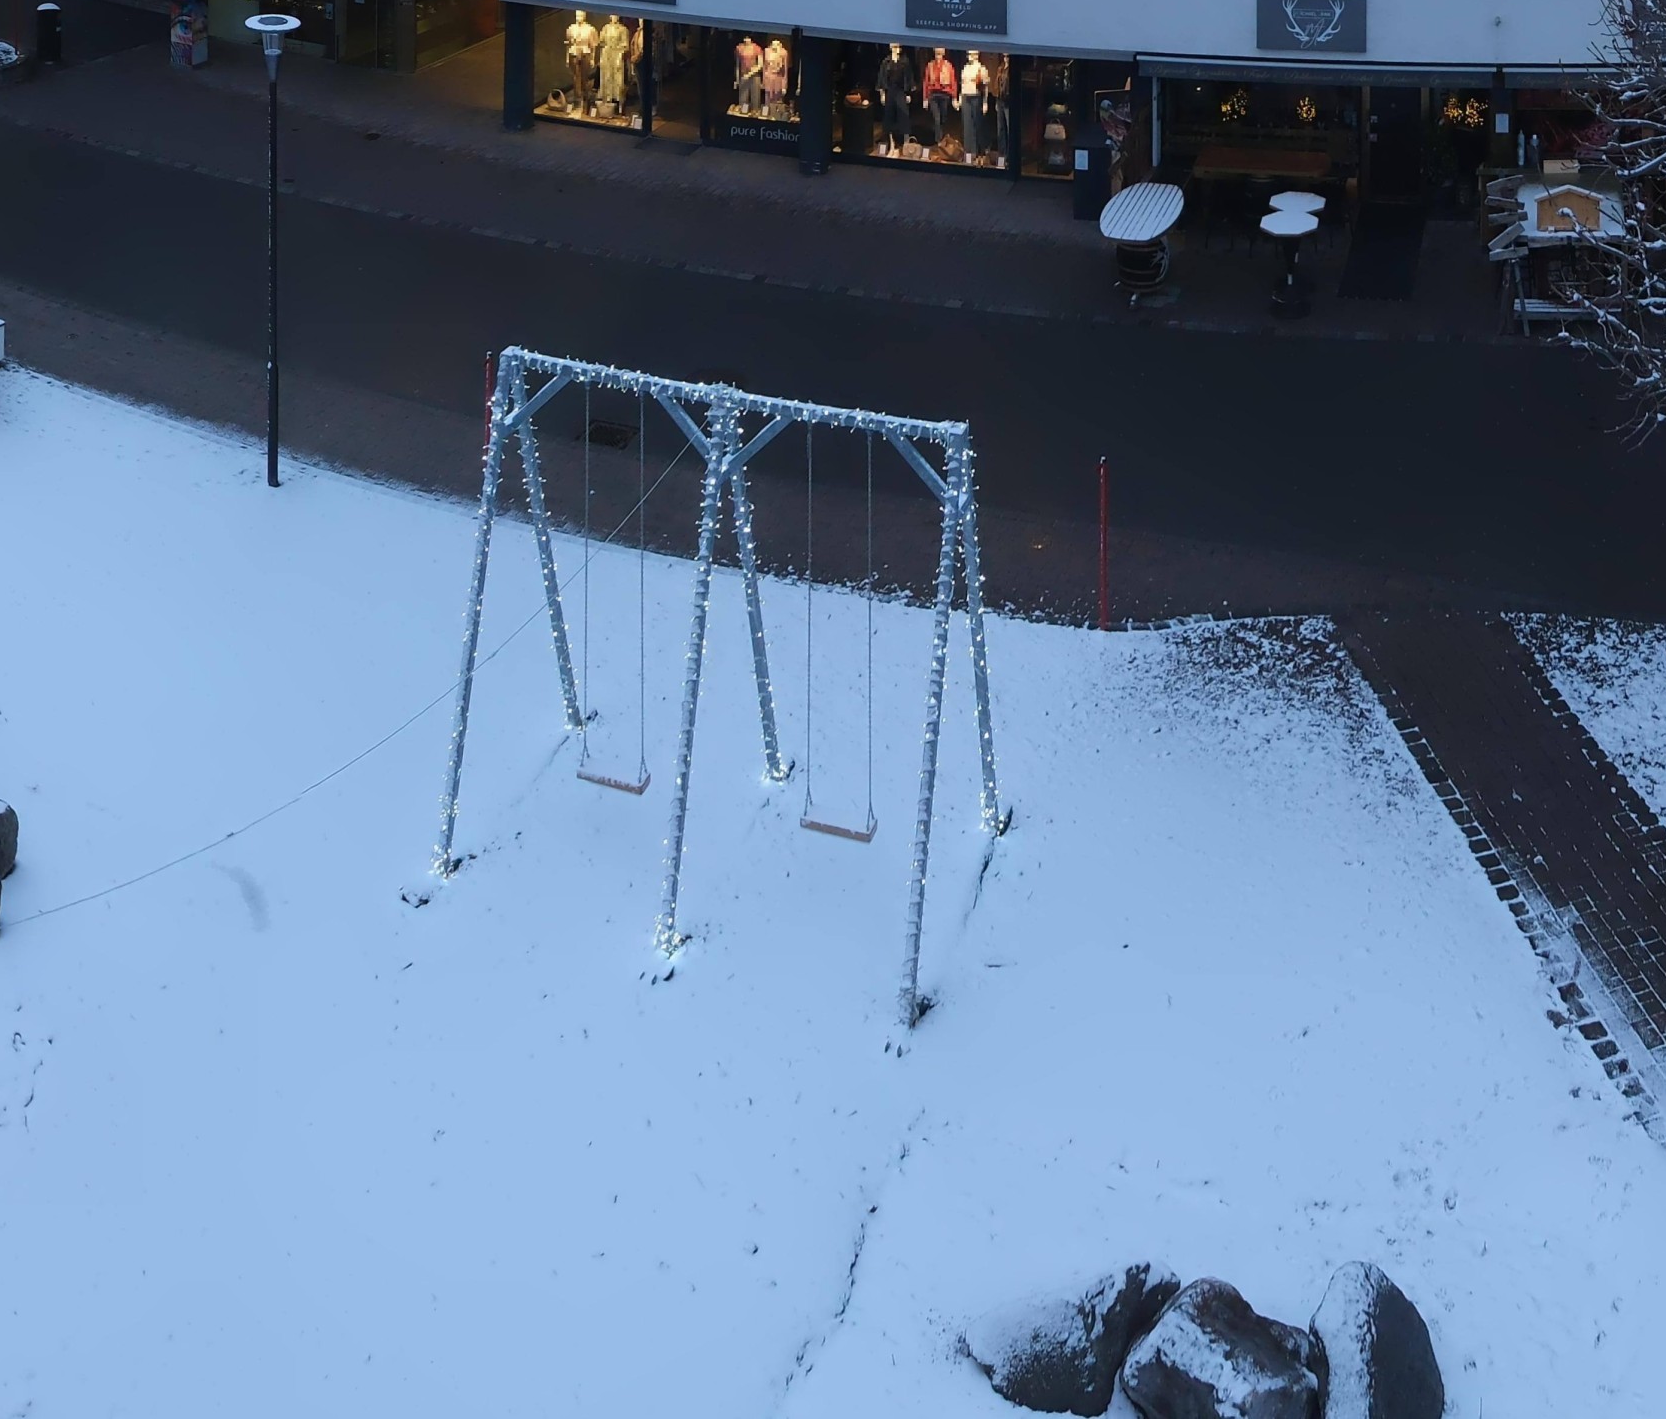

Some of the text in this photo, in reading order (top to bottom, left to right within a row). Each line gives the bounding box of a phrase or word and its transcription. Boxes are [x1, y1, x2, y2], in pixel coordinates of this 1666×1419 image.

[943, 3, 972, 11] SEEFELD
[915, 19, 945, 27] SEEFELD
[946, 21, 982, 30] SHOPPING
[730, 126, 757, 137] pure
